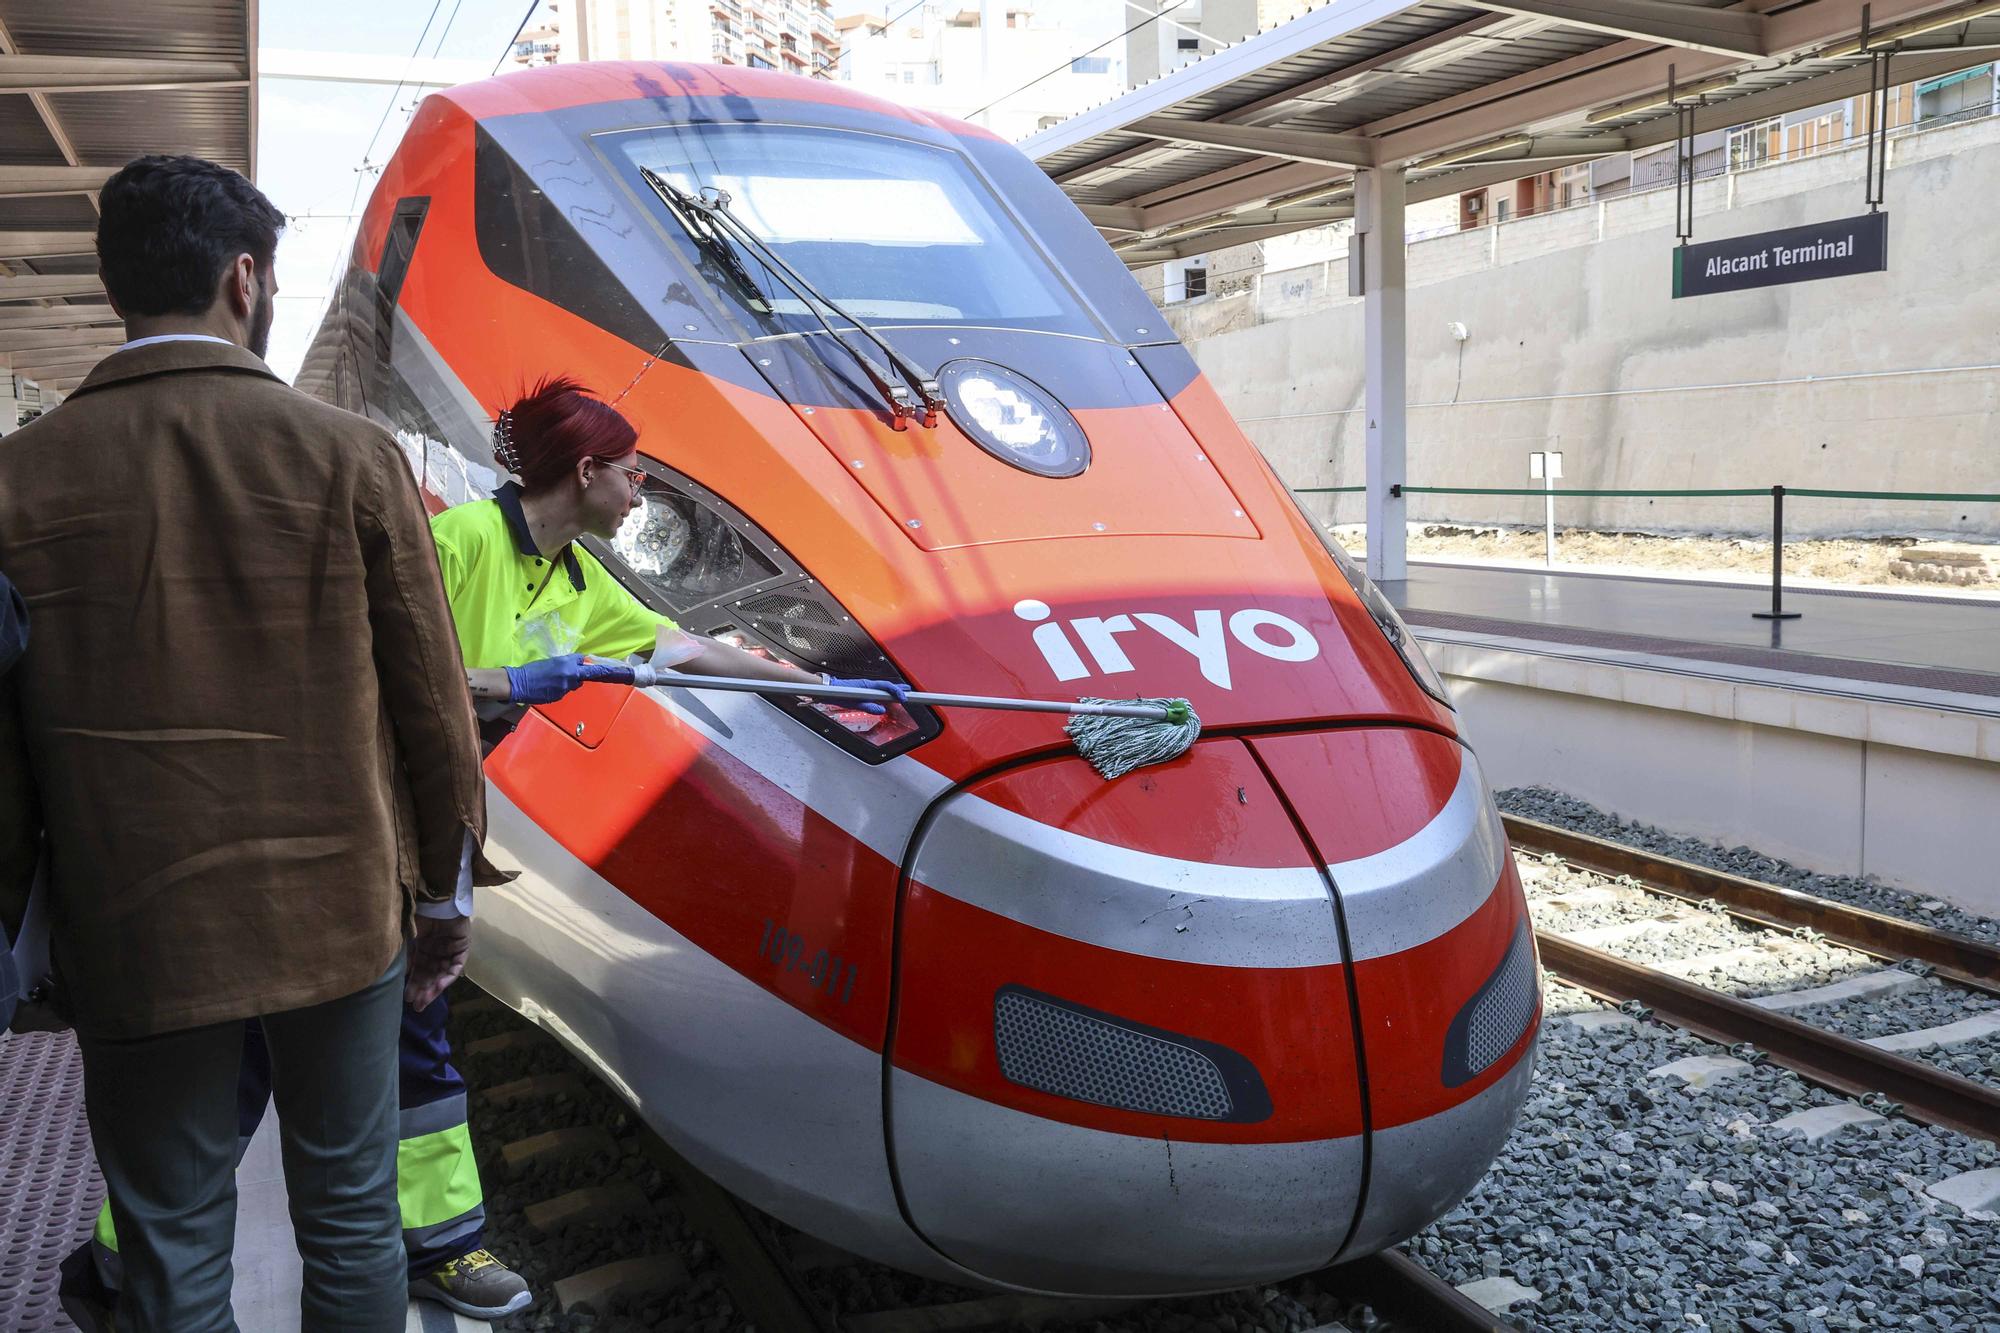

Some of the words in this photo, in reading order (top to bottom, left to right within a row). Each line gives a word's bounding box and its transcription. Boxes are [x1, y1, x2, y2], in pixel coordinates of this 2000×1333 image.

[1705, 249, 1768, 277] Alacant
[1773, 235, 1854, 267] Terminal
[1013, 599, 1320, 690] iryo
[758, 918, 858, 1004] 109-011
